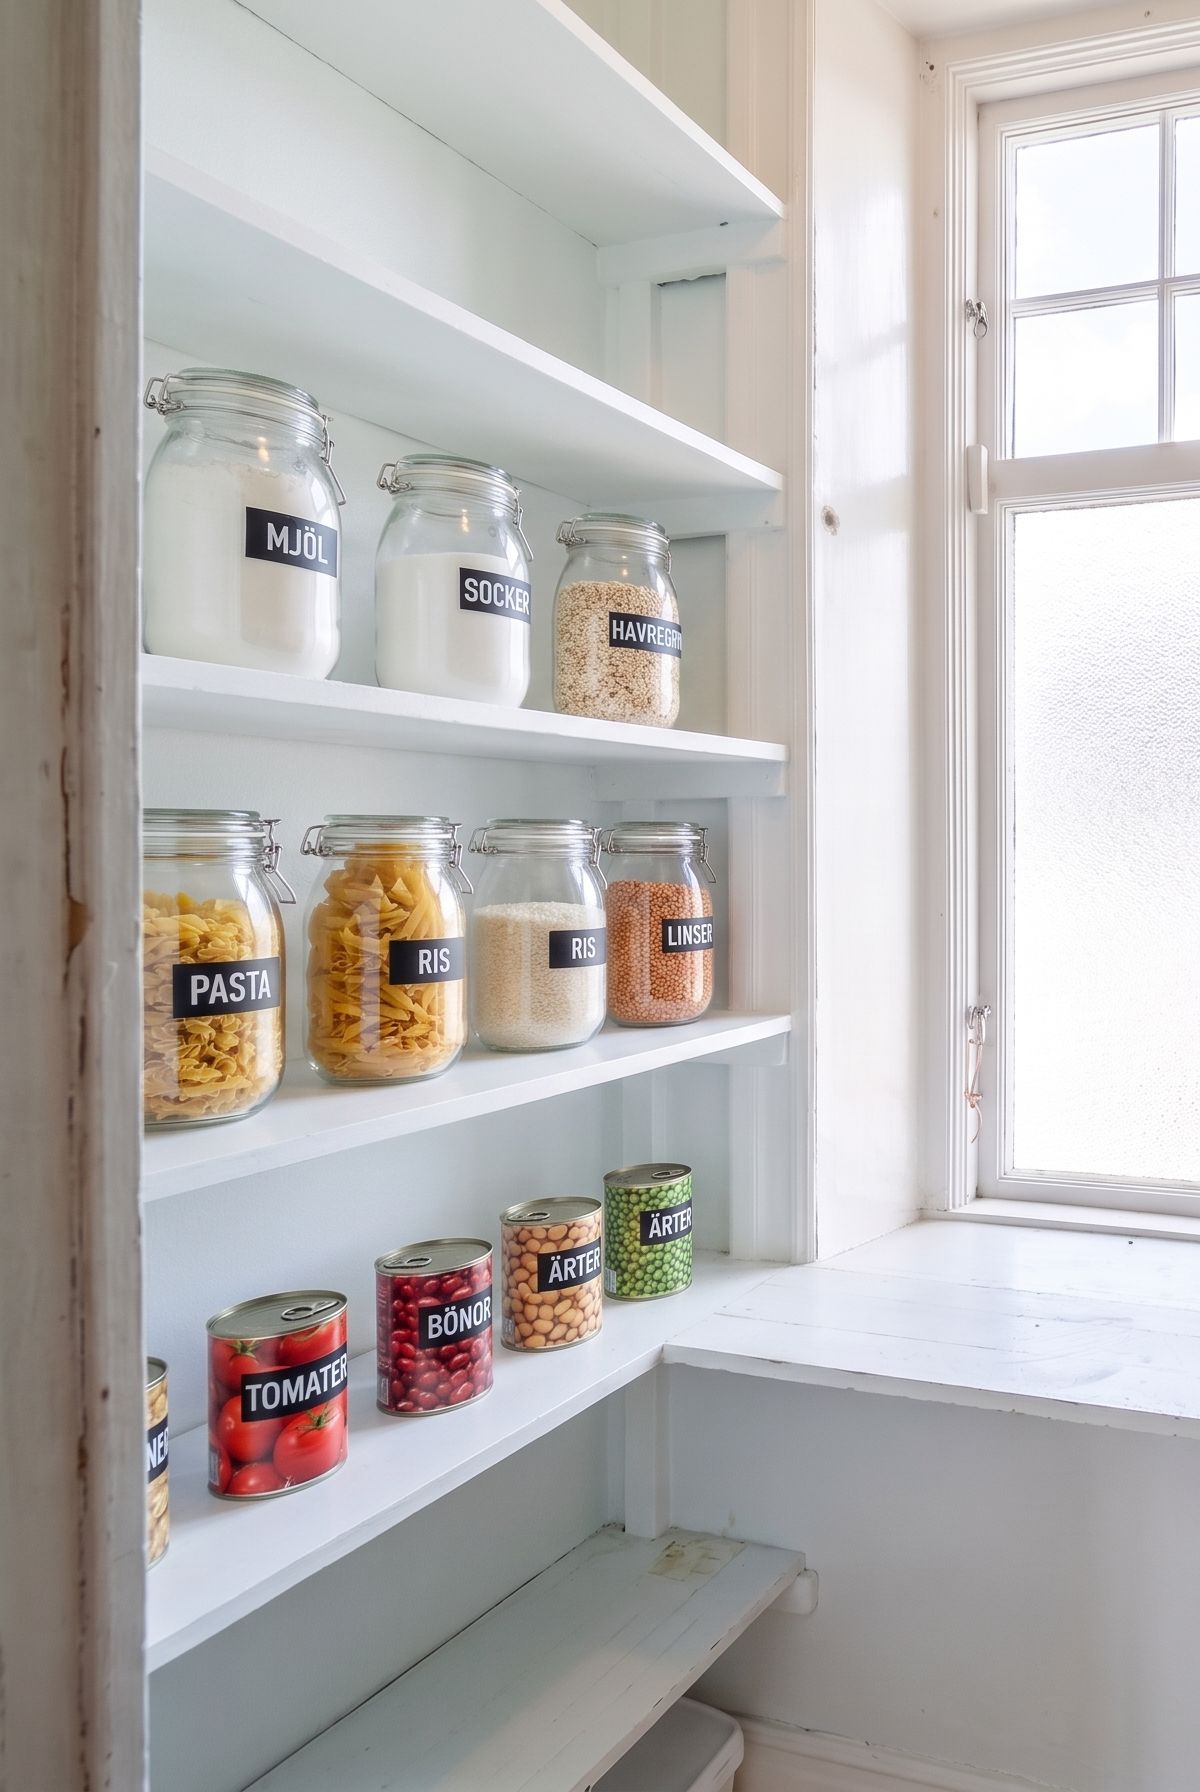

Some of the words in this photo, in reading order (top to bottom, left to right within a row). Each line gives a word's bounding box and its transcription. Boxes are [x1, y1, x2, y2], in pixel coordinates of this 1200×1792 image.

[267, 522, 329, 565] MJÖL
[464, 577, 530, 616] SOCKER
[572, 936, 596, 960] RIS
[668, 923, 713, 946] LINSER
[418, 947, 451, 975] RIS
[190, 969, 272, 1006] PASTA
[649, 1206, 692, 1239] ÄRTER
[548, 1246, 600, 1284] ÄRTER
[428, 1296, 492, 1340] BÖNOR
[245, 1352, 348, 1412] TOMATER
